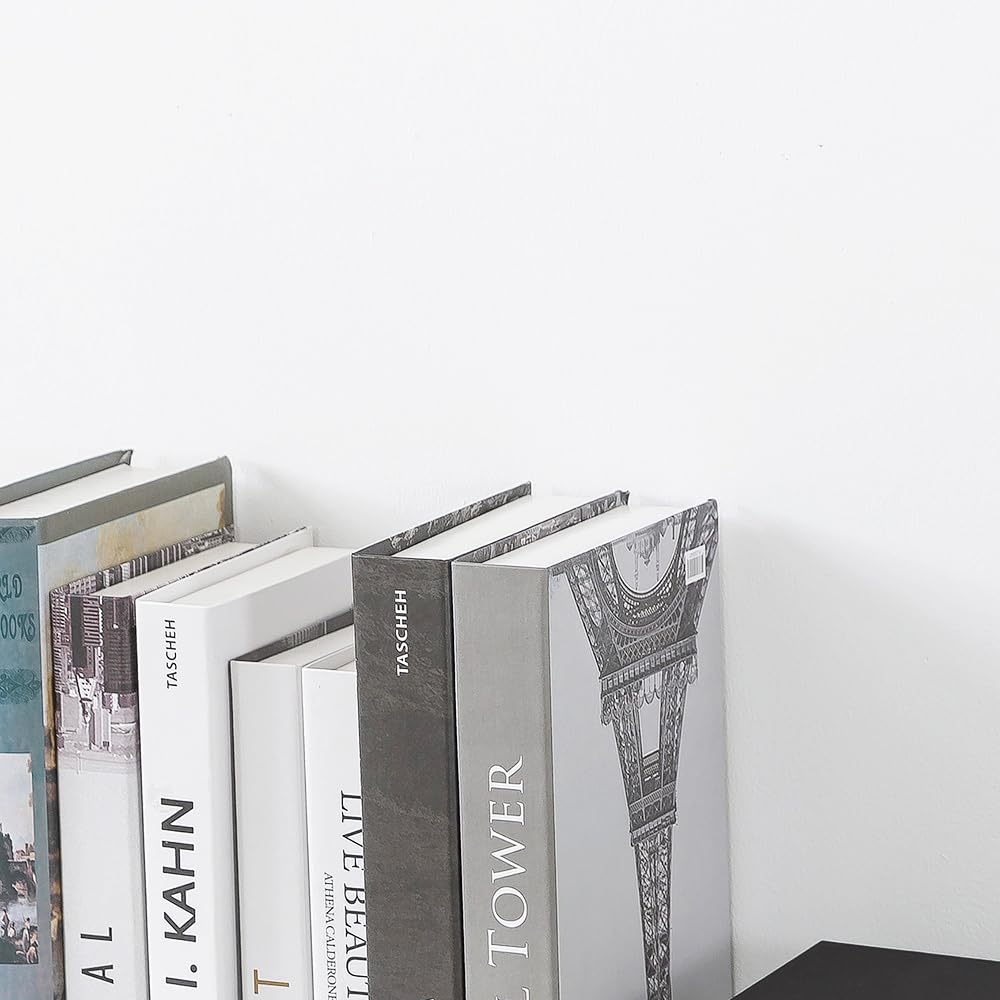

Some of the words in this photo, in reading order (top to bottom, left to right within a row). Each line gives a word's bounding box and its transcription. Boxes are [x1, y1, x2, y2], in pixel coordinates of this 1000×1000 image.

[161, 797, 197, 943] KAHN
[340, 789, 365, 872] LIVE
[487, 755, 529, 968] TOWER
[324, 872, 335, 924] ATHENA
[165, 964, 198, 988] I.
